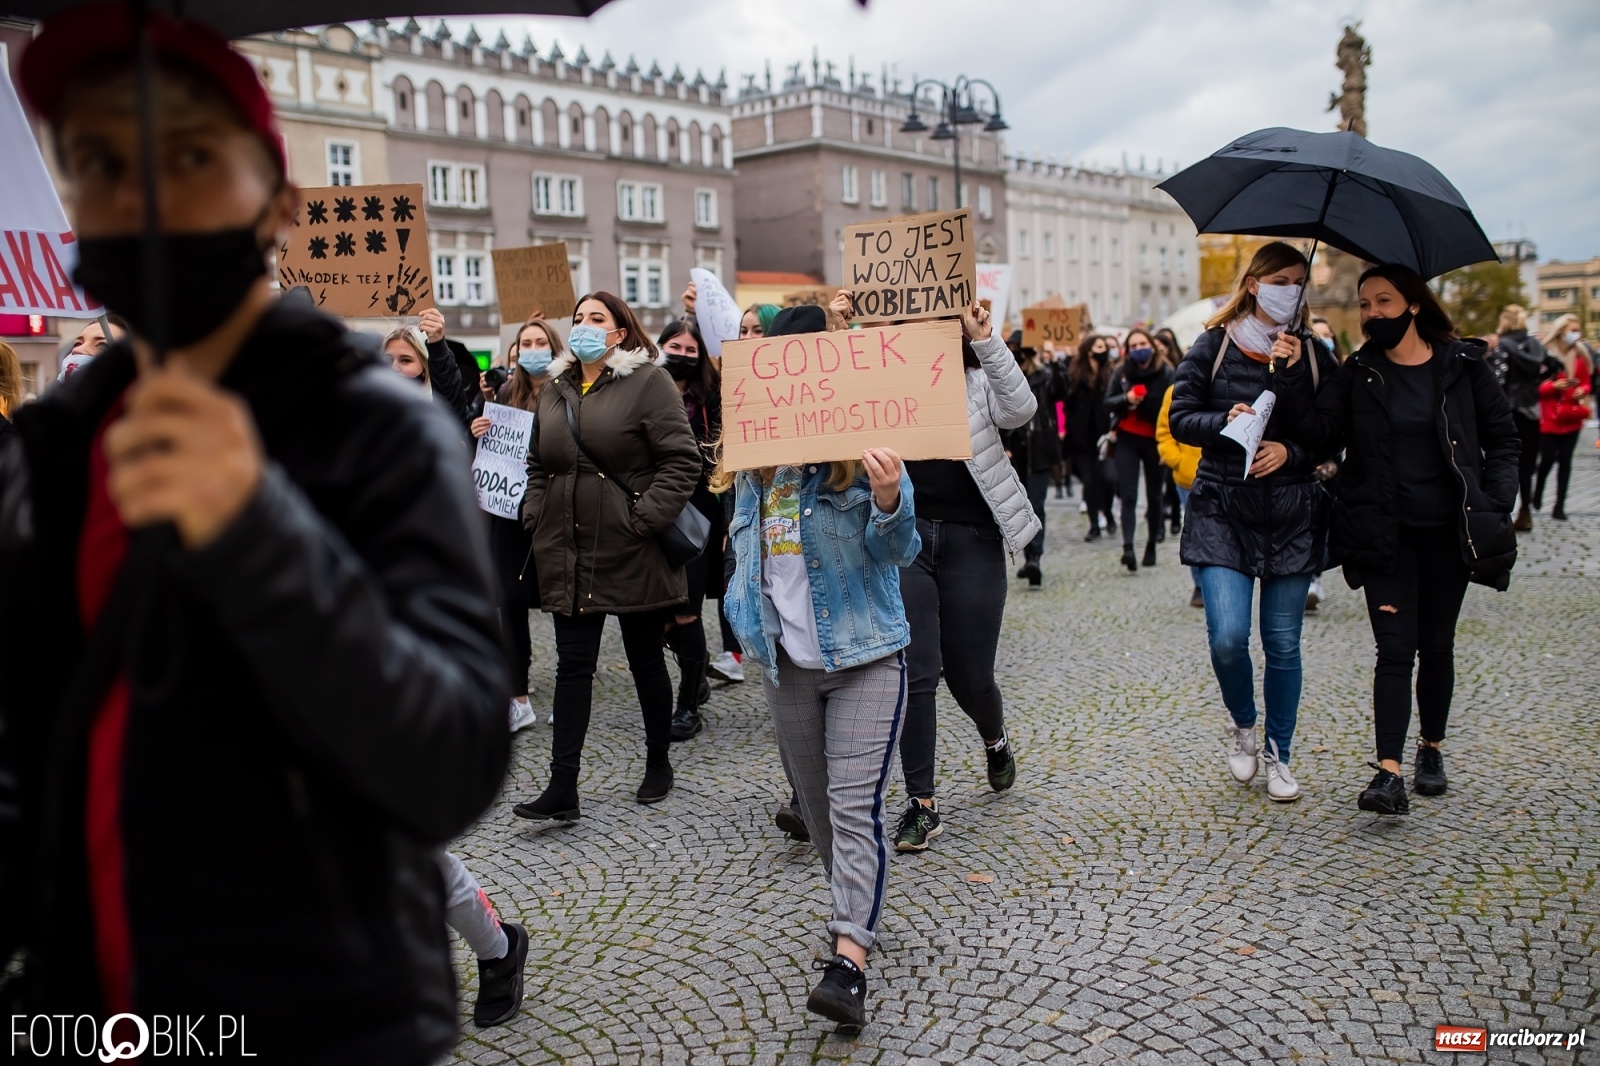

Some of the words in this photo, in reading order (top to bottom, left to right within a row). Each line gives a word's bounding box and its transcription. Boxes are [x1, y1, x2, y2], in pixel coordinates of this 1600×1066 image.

[855, 230, 892, 256] TO
[904, 213, 967, 258] JEST
[306, 272, 350, 284] GODEK
[356, 272, 381, 284] TEŻ
[545, 262, 567, 284] PIS
[854, 257, 938, 285] WOJNA
[945, 252, 962, 280] Z
[1041, 324, 1075, 342] SUS
[751, 331, 907, 380] GODEK
[766, 379, 835, 408] WAS
[737, 417, 781, 443] THE
[793, 397, 919, 437] IMPOSTOR
